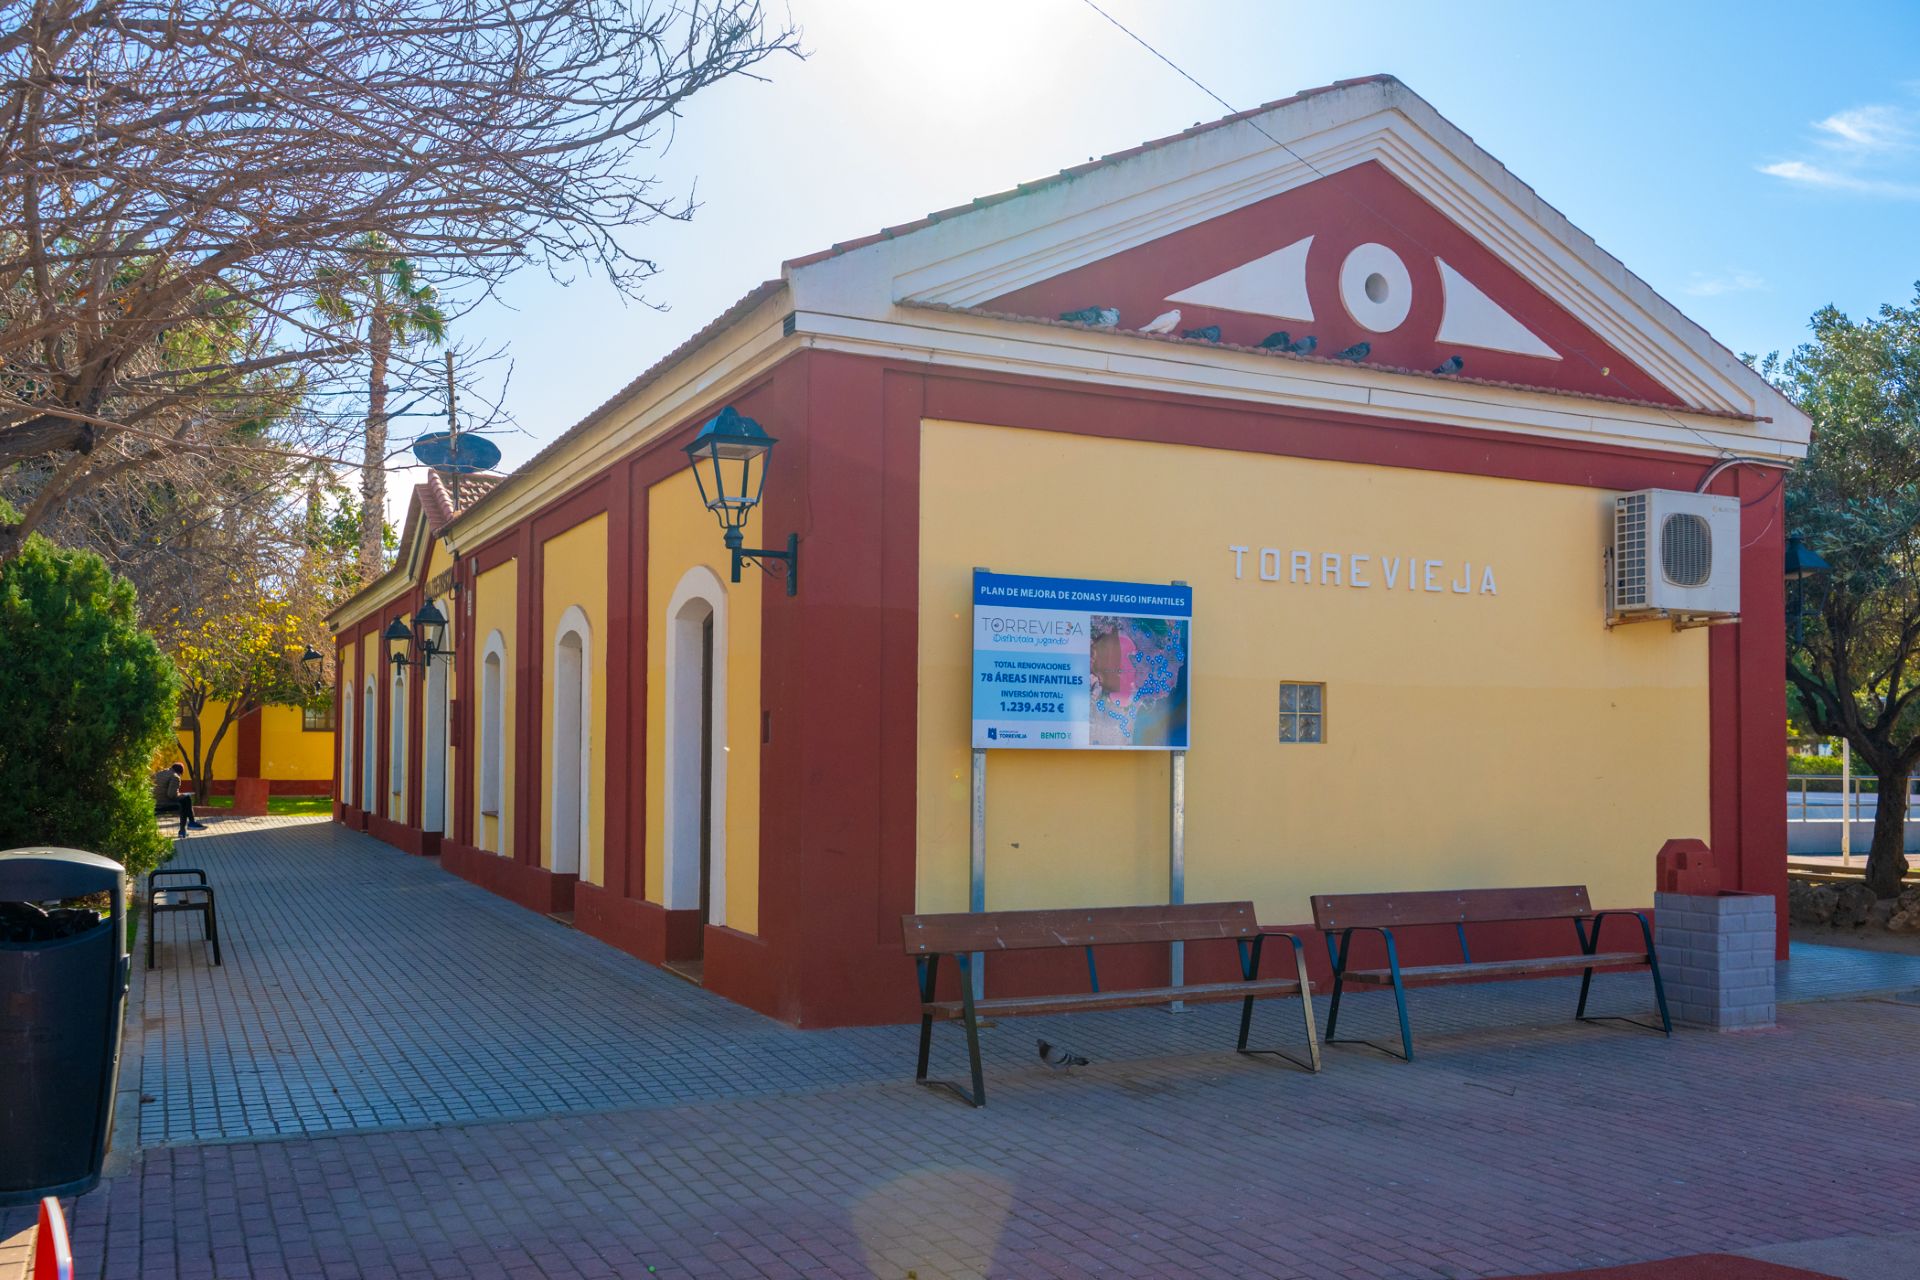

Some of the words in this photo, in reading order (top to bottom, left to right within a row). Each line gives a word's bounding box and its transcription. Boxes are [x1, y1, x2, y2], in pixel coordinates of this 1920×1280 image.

[1229, 545, 1497, 595] TORREVIEJA
[980, 586, 1005, 596] PLAN
[1006, 587, 1019, 597] DE
[1020, 588, 1057, 599] MEJORA
[1058, 590, 1070, 600] DE
[1071, 591, 1101, 601] ZONAS
[1101, 593, 1108, 602] Y
[1109, 594, 1137, 603] JUEGO
[1138, 595, 1185, 606] INFANTILES
[994, 661, 1016, 669] TOTAL
[1017, 662, 1071, 671] RENOVACIONES
[981, 672, 993, 682] 78
[994, 671, 1027, 684] ÁREAS
[1028, 674, 1083, 685] INFANTILES
[1001, 689, 1039, 698] INVERSIÓN
[1039, 691, 1064, 699] TOTAL:
[1000, 701, 1055, 713] 1.239.452
[1057, 703, 1065, 713] €
[1040, 732, 1067, 740] BENITO
